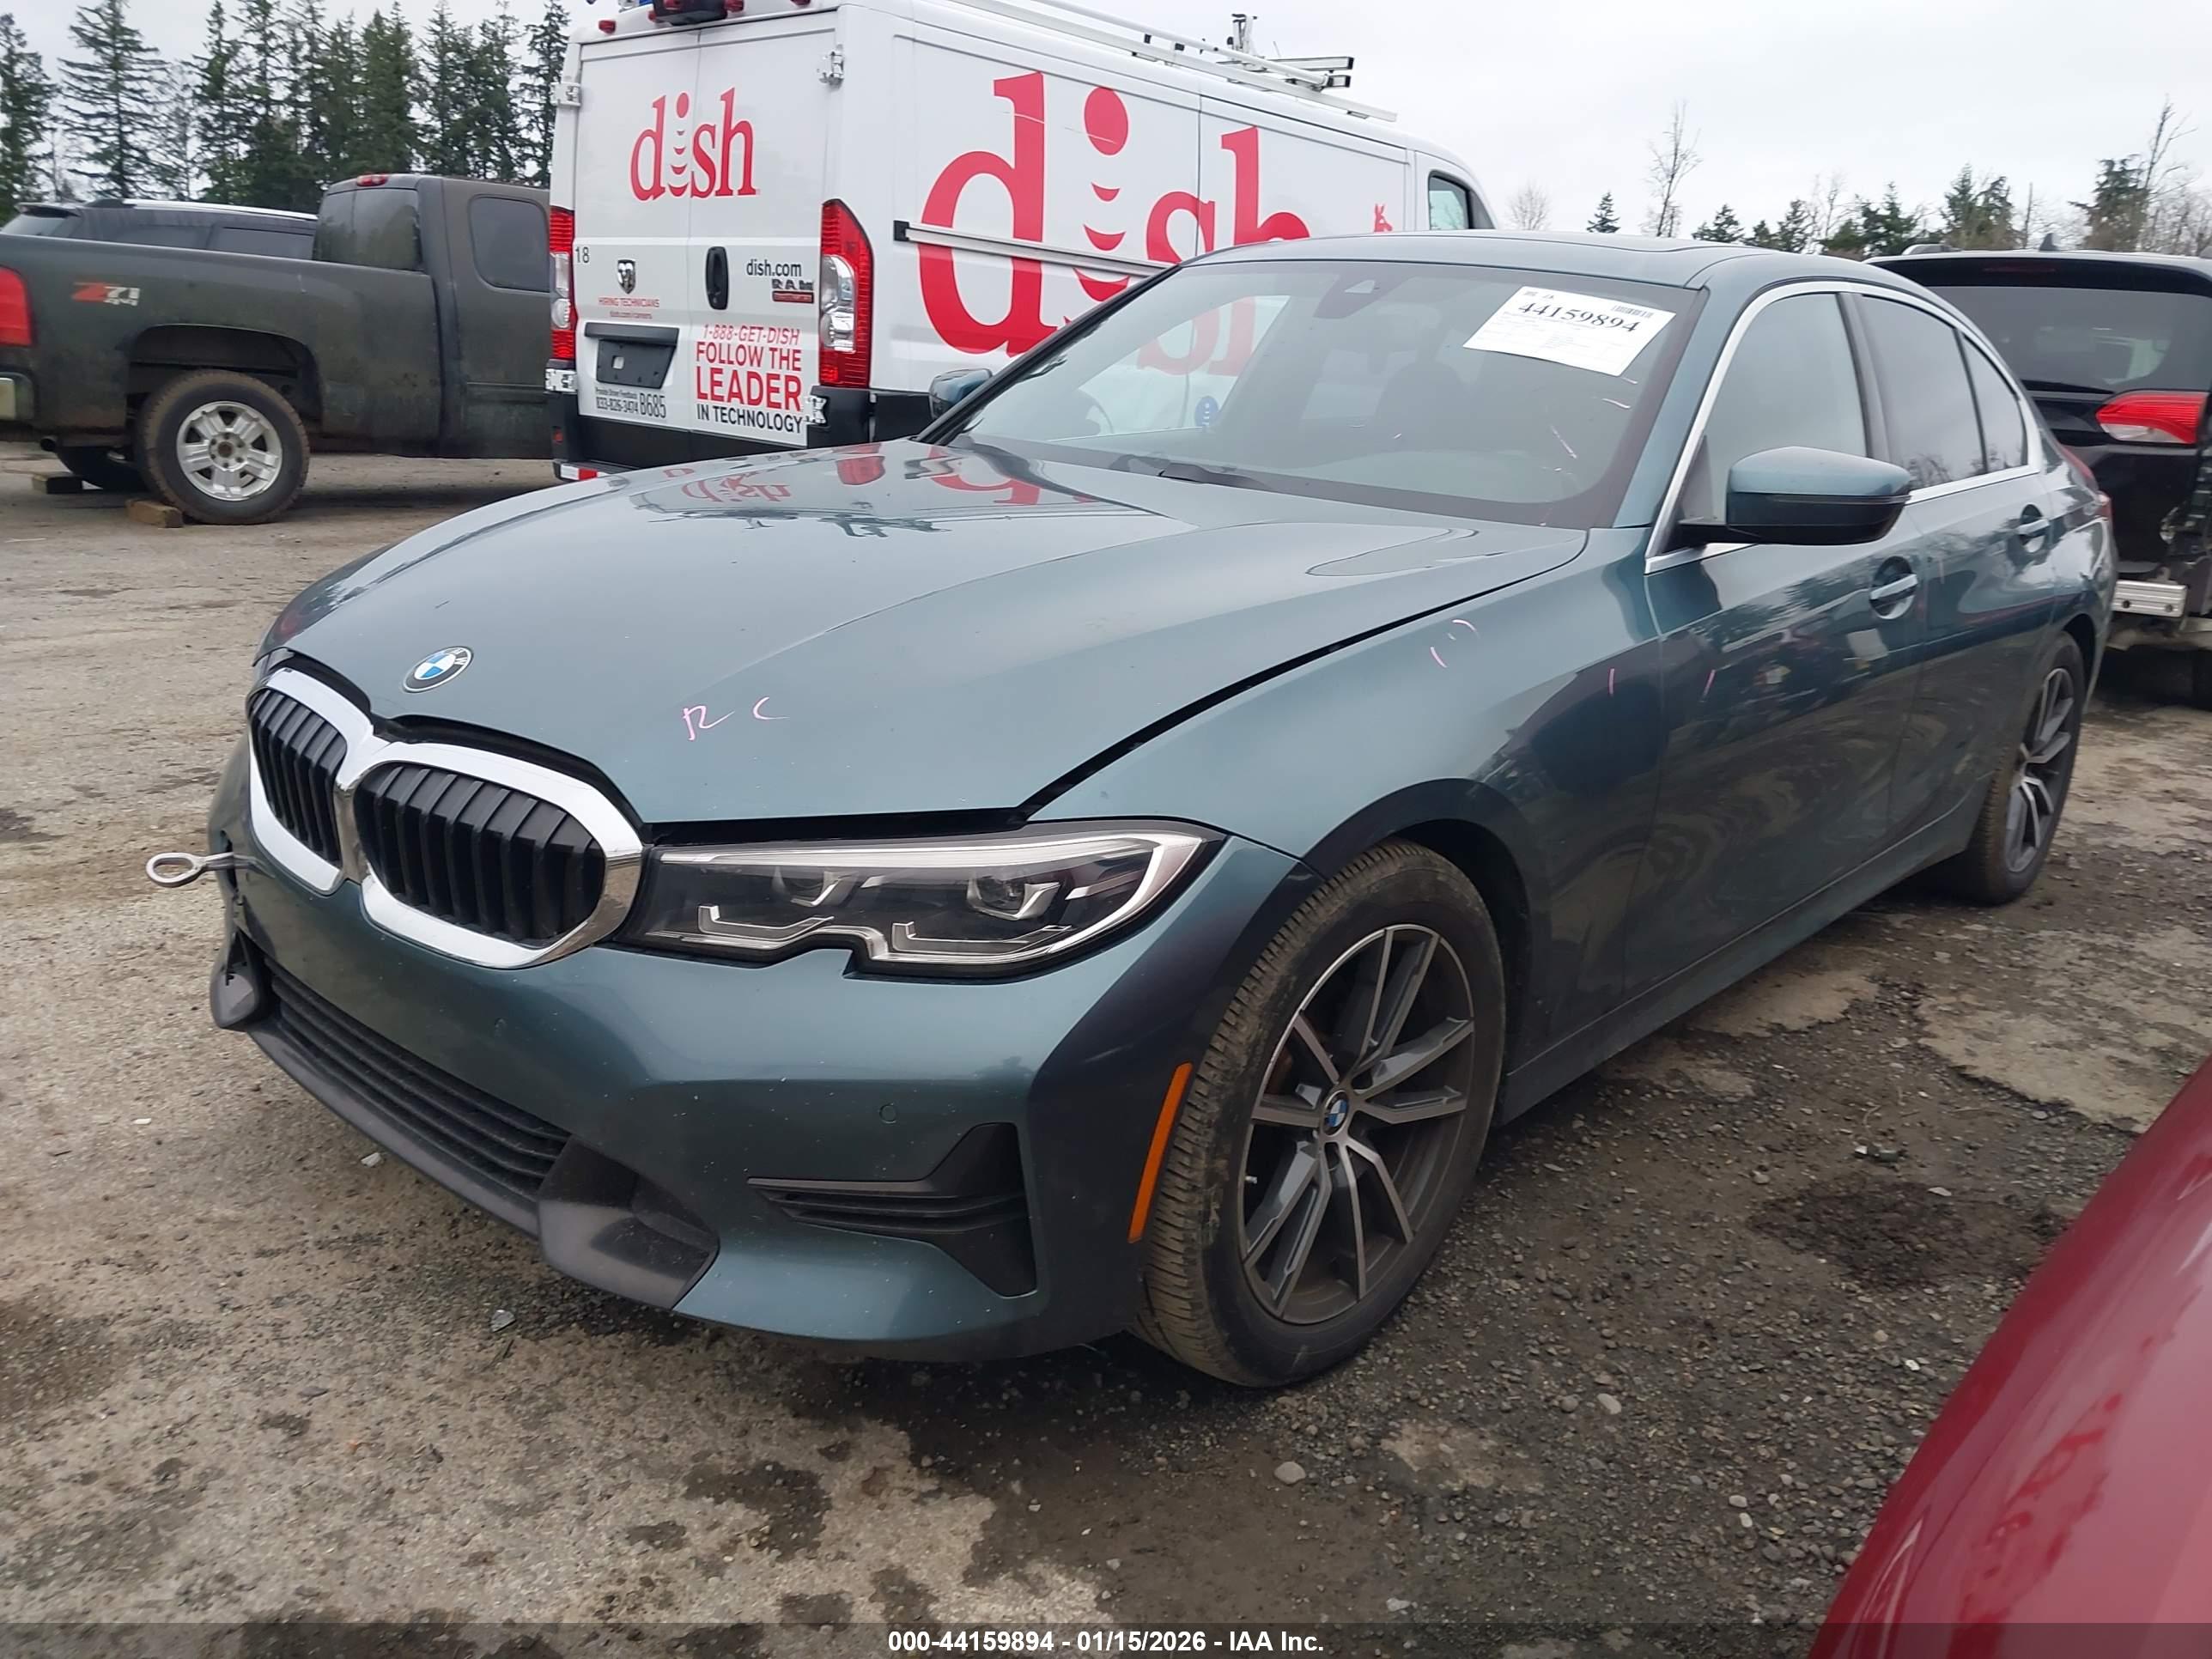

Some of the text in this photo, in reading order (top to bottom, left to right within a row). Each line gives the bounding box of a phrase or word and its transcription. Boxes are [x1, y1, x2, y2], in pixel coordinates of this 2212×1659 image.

[630, 87, 757, 201] dish
[575, 246, 590, 263] 18
[746, 258, 802, 276] dish.com
[71, 283, 140, 302] Z71
[1518, 302, 1640, 332] 44159894
[704, 324, 800, 345] 1-888-GET-DISH
[696, 341, 802, 371] FOLLOW THE
[696, 366, 802, 412] LEADER
[640, 392, 666, 418] B685
[696, 404, 803, 434] IN TECHNOLOGY
